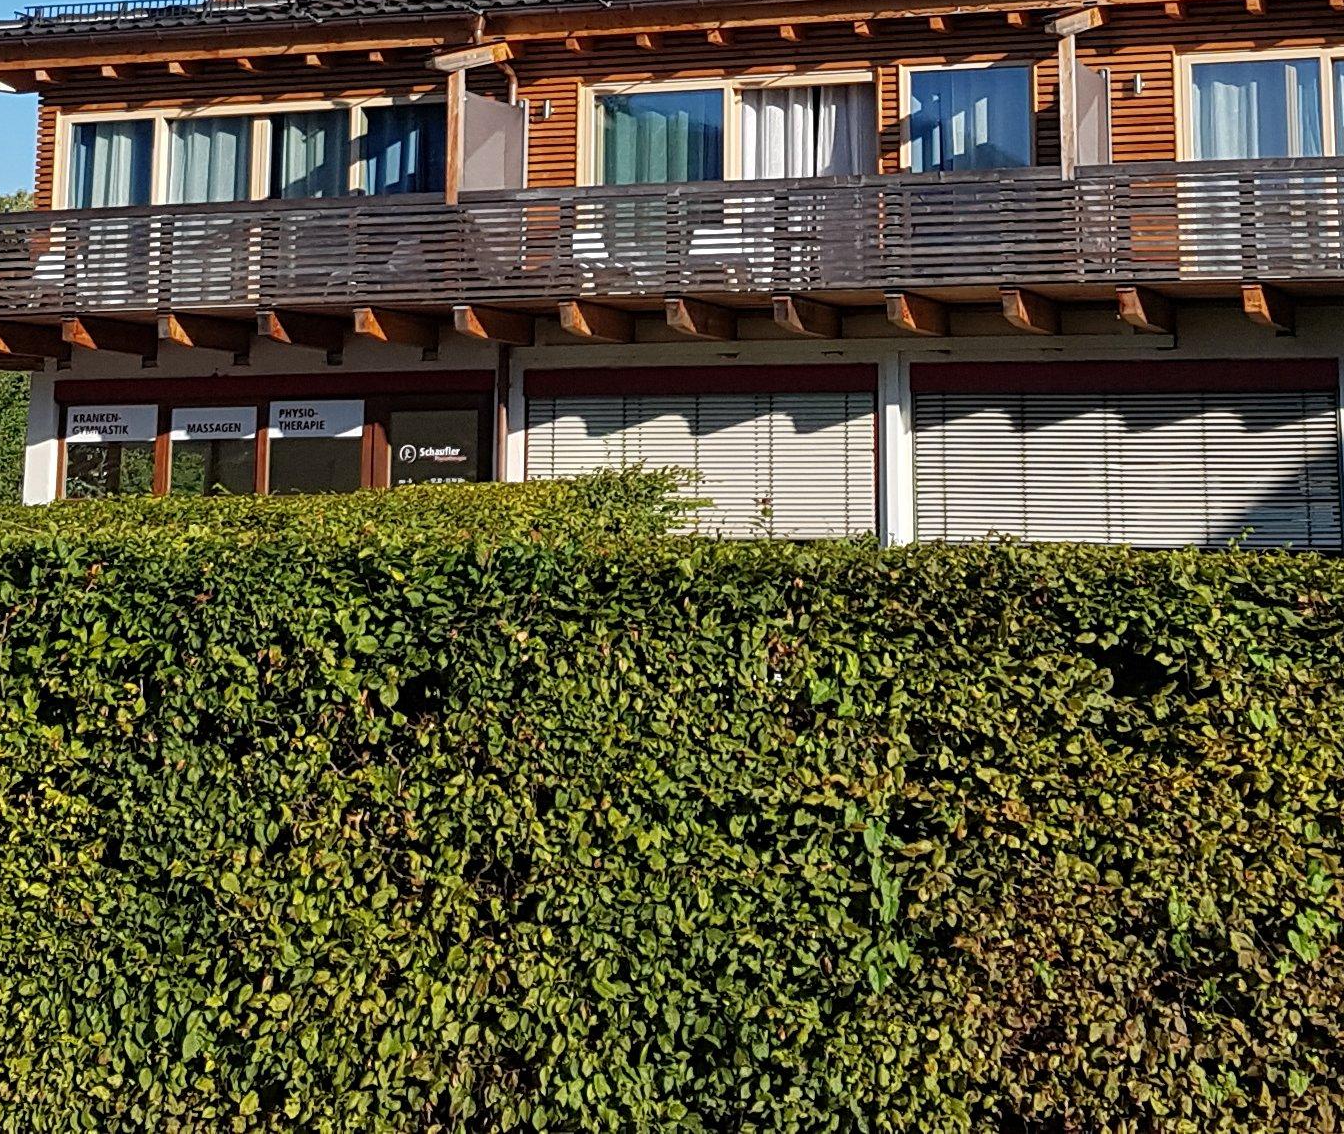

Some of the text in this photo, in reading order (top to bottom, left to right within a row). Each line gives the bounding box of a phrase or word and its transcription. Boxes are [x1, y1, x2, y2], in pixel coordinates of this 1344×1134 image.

[73, 413, 122, 423] KRANKEN-
[278, 408, 319, 418] PHYSIO-
[187, 423, 242, 433] MASSAGEN
[279, 420, 326, 430] THERAPIE
